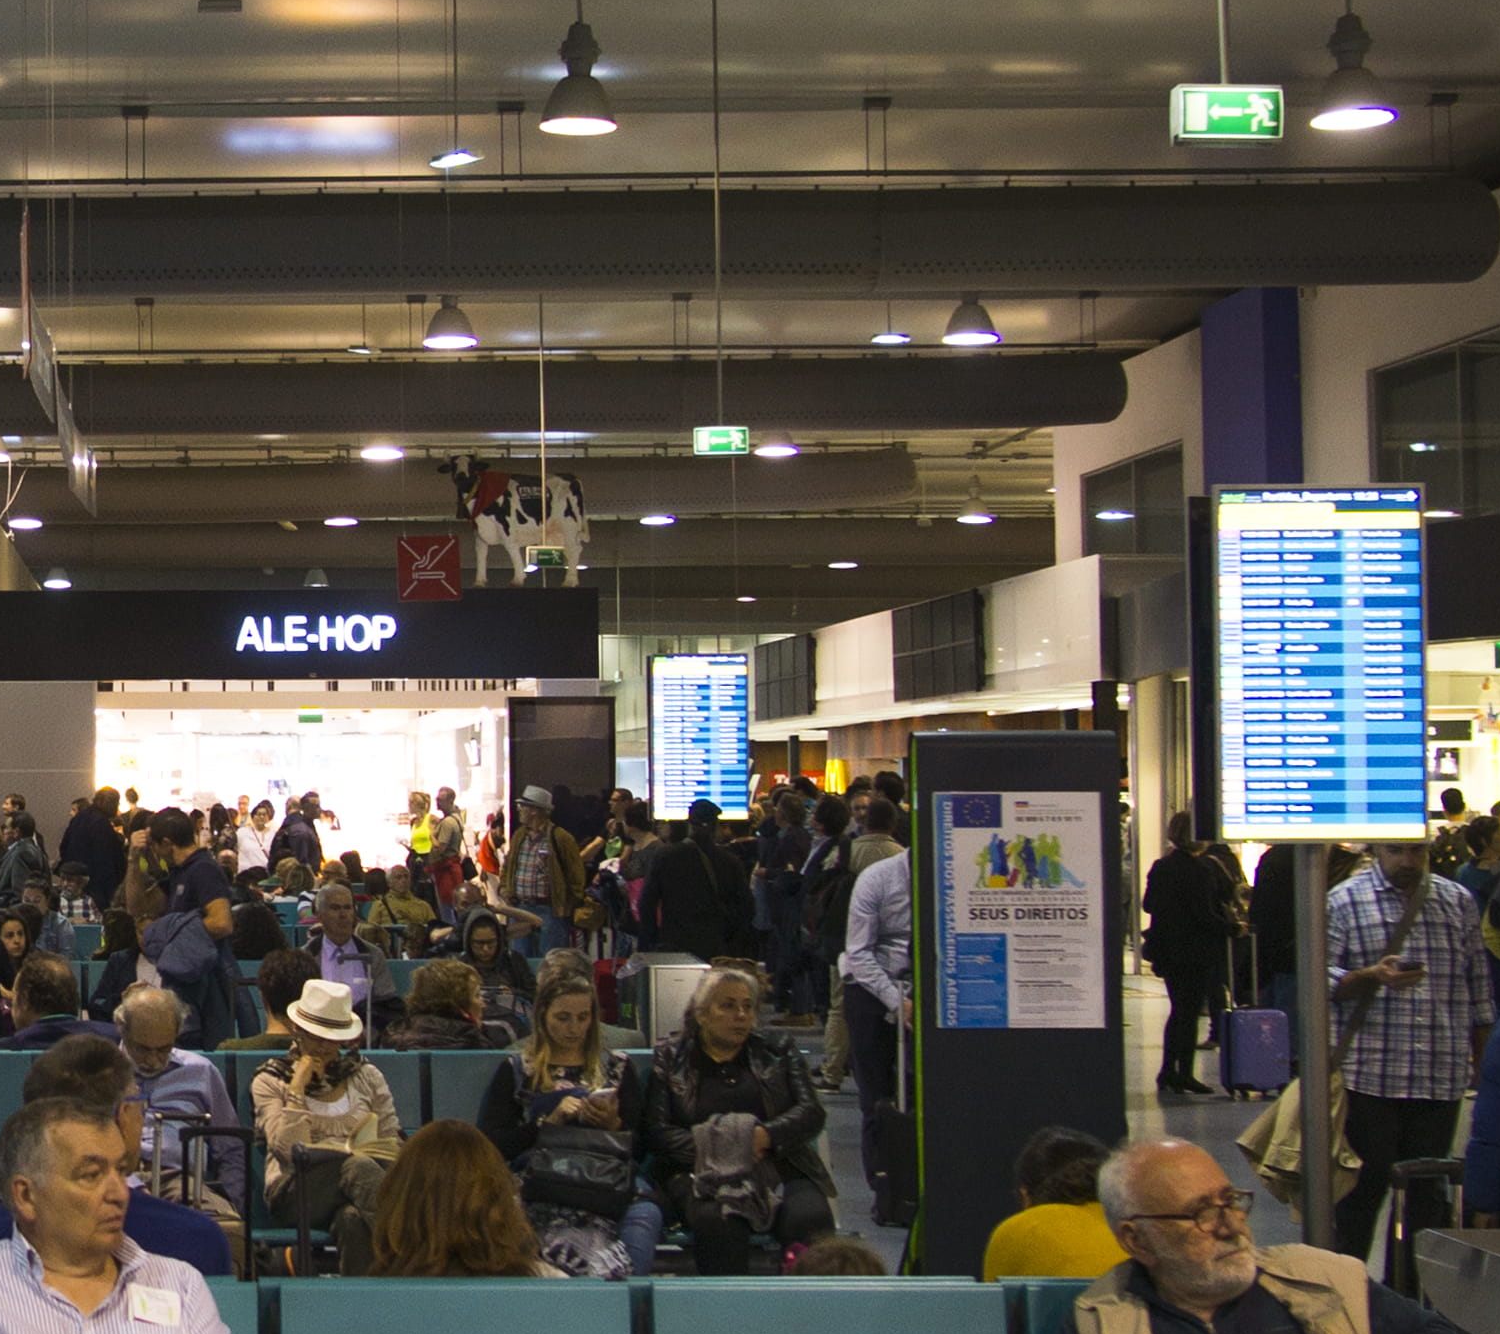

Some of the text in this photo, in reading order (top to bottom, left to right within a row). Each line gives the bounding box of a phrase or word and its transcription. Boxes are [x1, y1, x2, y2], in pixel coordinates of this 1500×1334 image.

[235, 614, 397, 653] ALE-HOP
[968, 907, 1088, 921] SEUS DIREITOS
